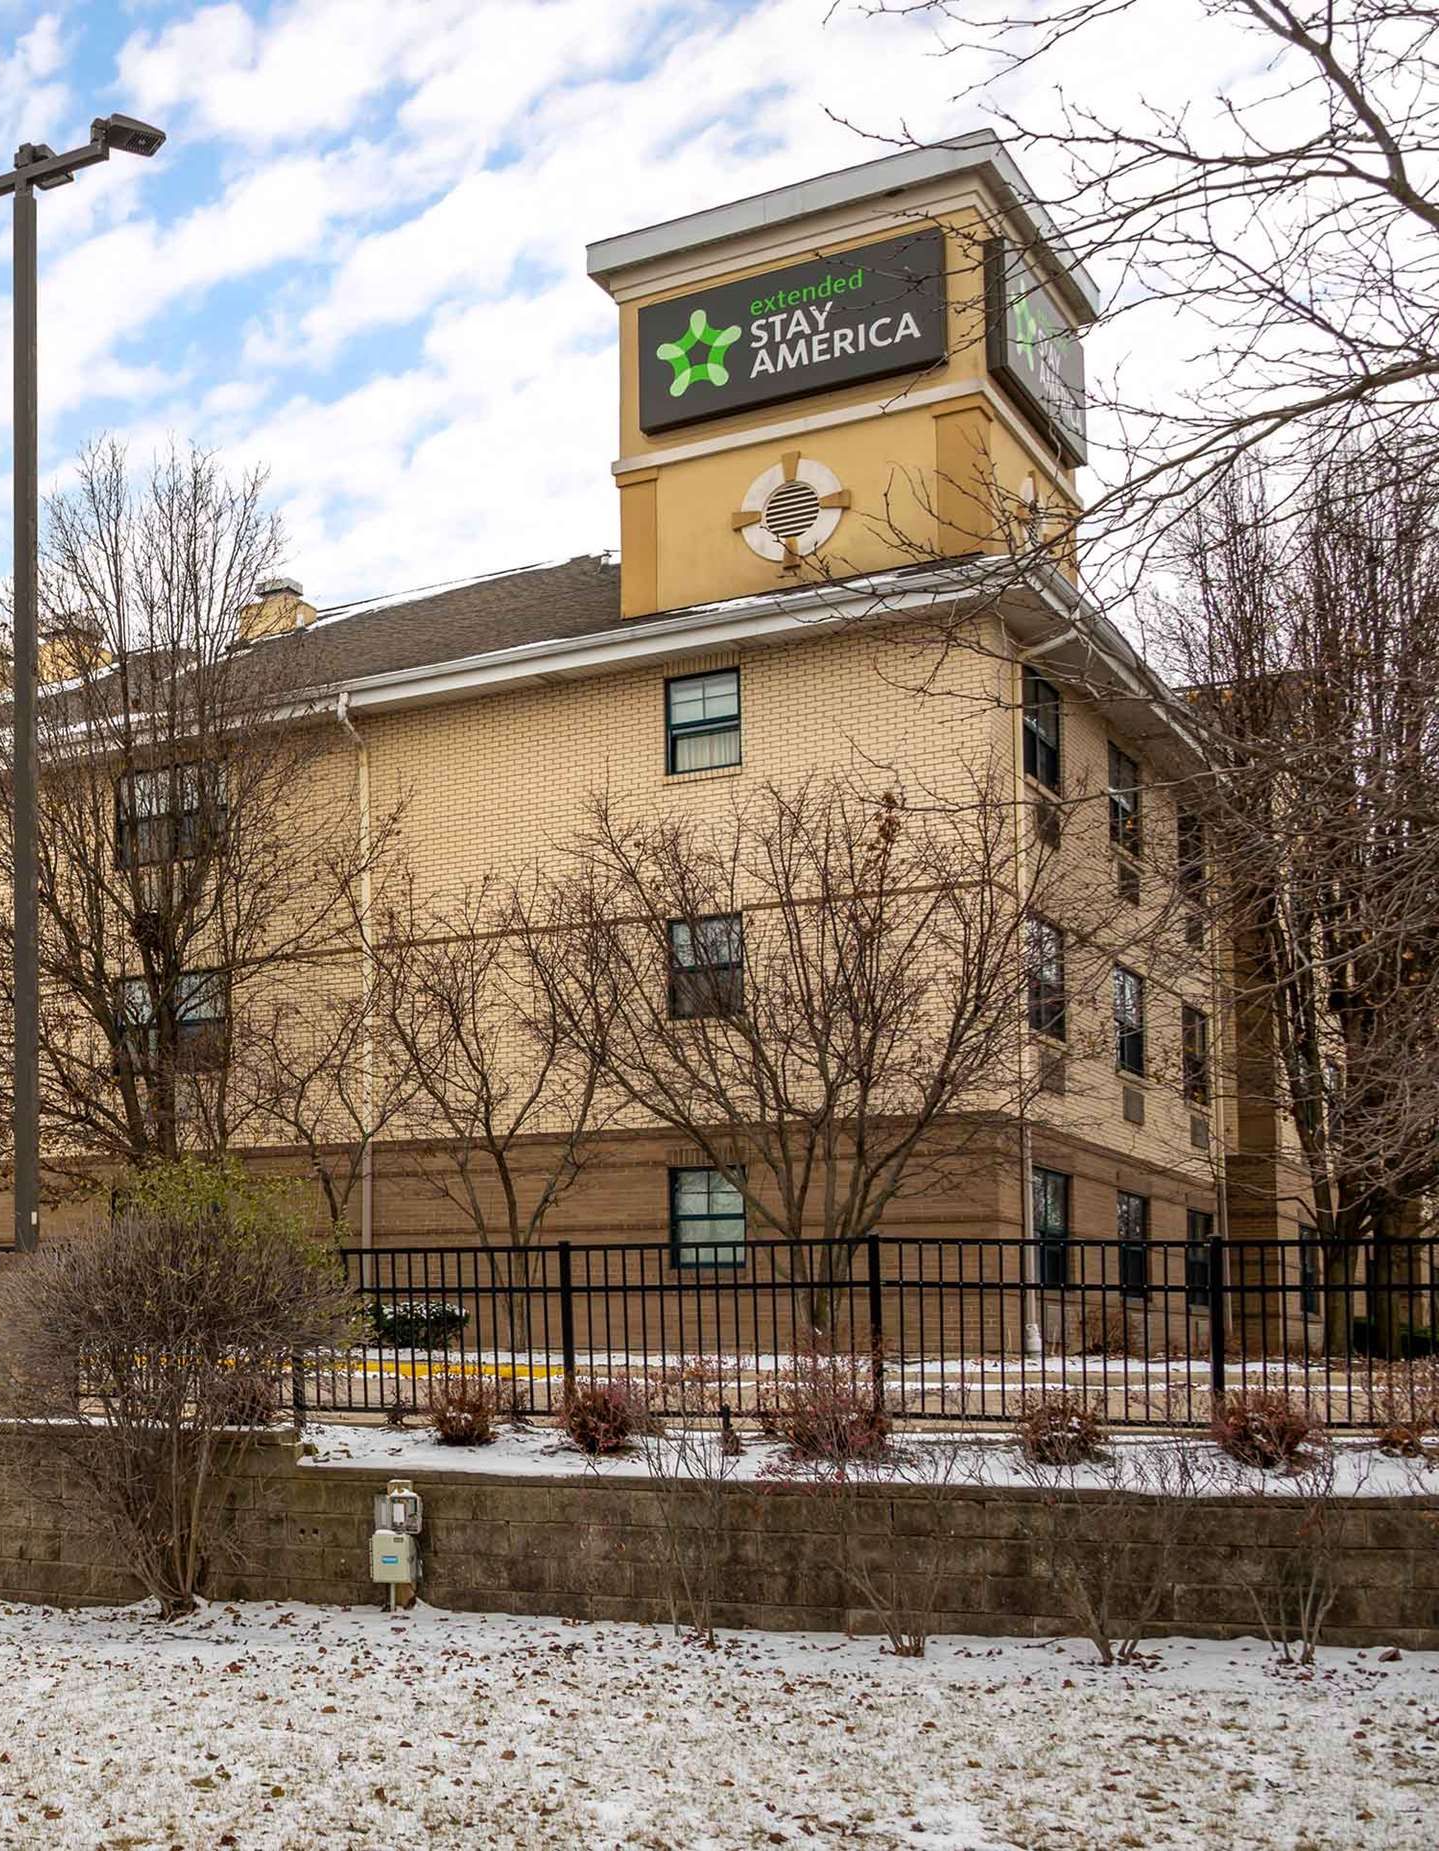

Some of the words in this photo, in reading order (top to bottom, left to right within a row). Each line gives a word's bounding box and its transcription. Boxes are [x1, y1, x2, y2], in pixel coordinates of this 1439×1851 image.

[750, 268, 864, 316] extended
[750, 301, 833, 348] STAY
[750, 312, 921, 379] AMERICA
